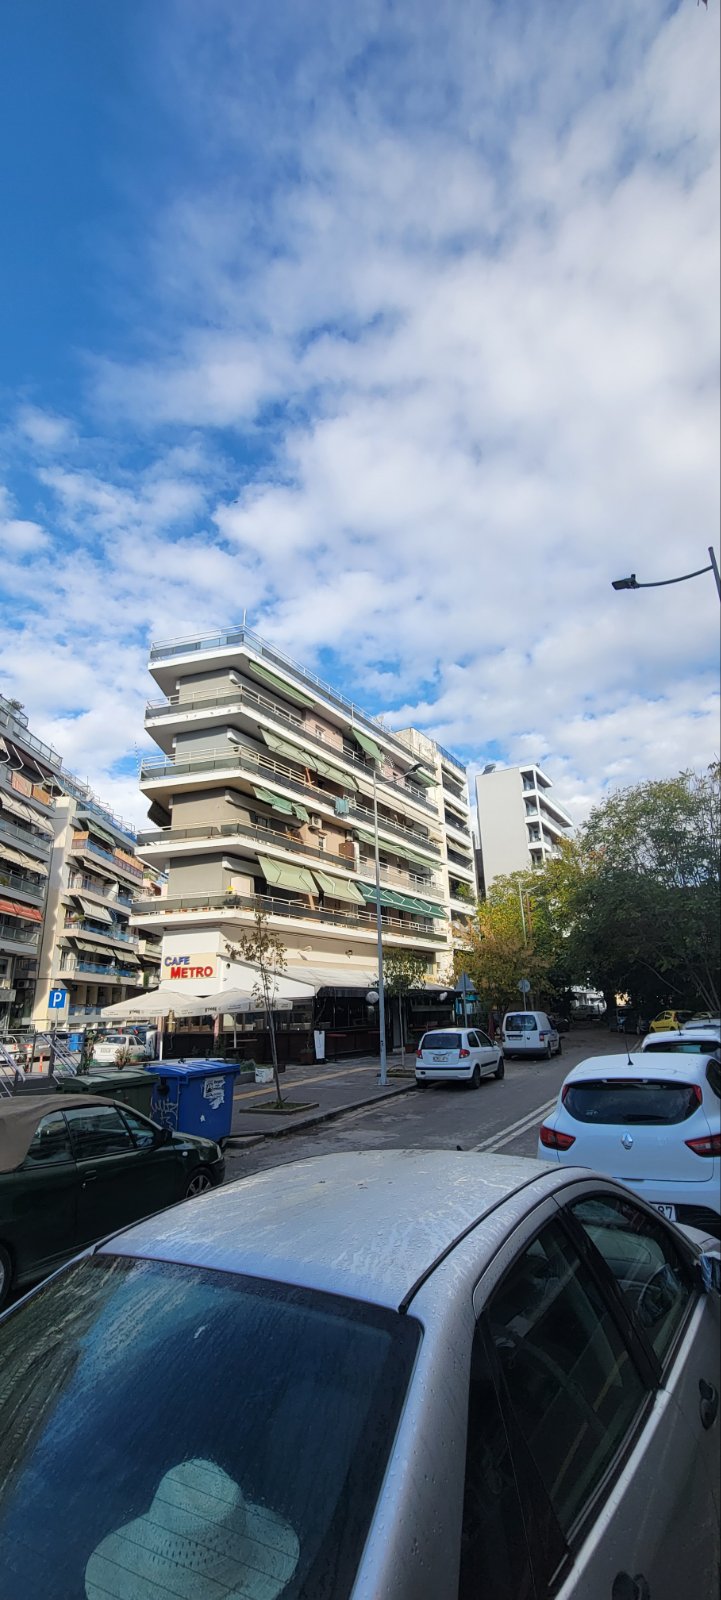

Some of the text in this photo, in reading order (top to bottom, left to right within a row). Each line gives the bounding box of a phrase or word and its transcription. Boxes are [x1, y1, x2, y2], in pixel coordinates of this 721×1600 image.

[164, 956, 190, 967] CAFE
[170, 965, 213, 979] METRO
[52, 991, 63, 1008] P
